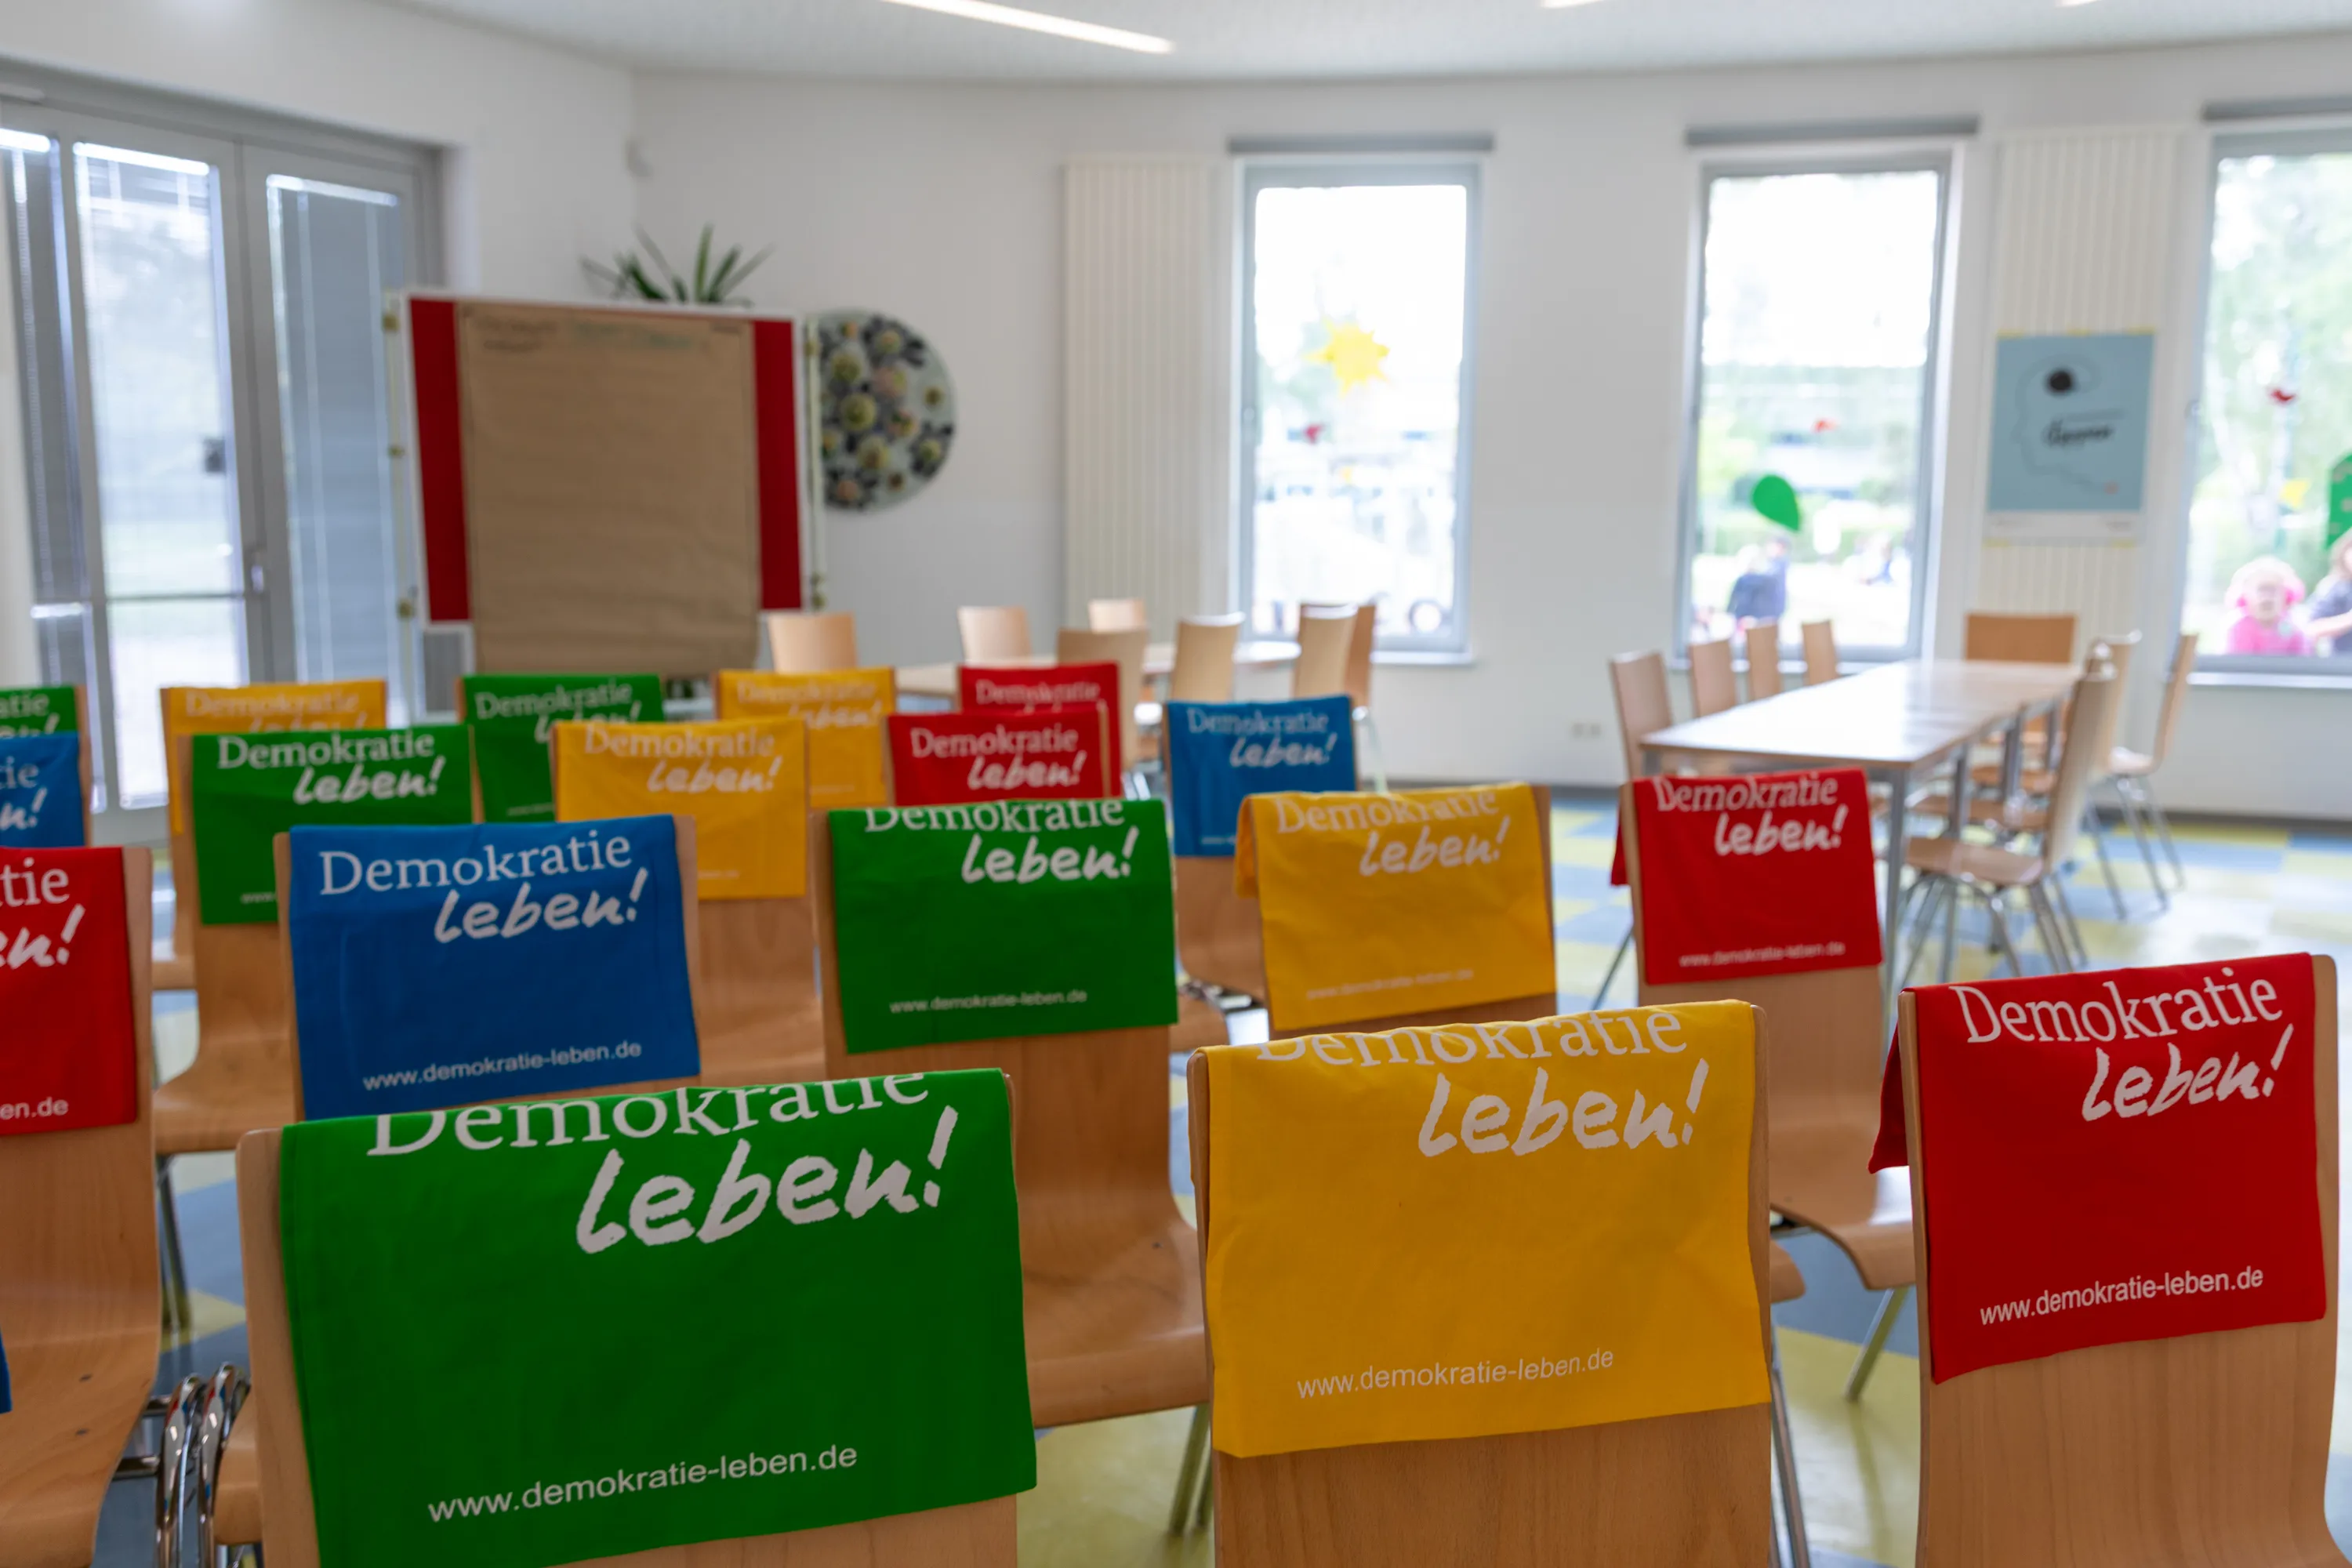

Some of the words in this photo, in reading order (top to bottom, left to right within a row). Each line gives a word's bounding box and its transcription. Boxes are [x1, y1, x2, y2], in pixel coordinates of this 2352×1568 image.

[217, 730, 435, 769] Demokratie
[585, 724, 776, 758] Demokratie
[910, 723, 1079, 758] Demokratie
[1274, 790, 1500, 834] Demokratie
[1652, 771, 1838, 812] Demokratie
[865, 800, 1125, 833] Demokratie
[319, 829, 632, 895] Demokratie
[890, 989, 1088, 1014] www.demokratie-leben.de
[1949, 967, 2283, 1044] Demokratie
[362, 1041, 643, 1091] www.demokratie-leben.de
[1980, 1265, 2264, 1326] www.demokratie-leben.de
[1297, 1348, 1613, 1399] www.demokratie-leben.de
[427, 1444, 858, 1523] www.demokratie-leben.de
